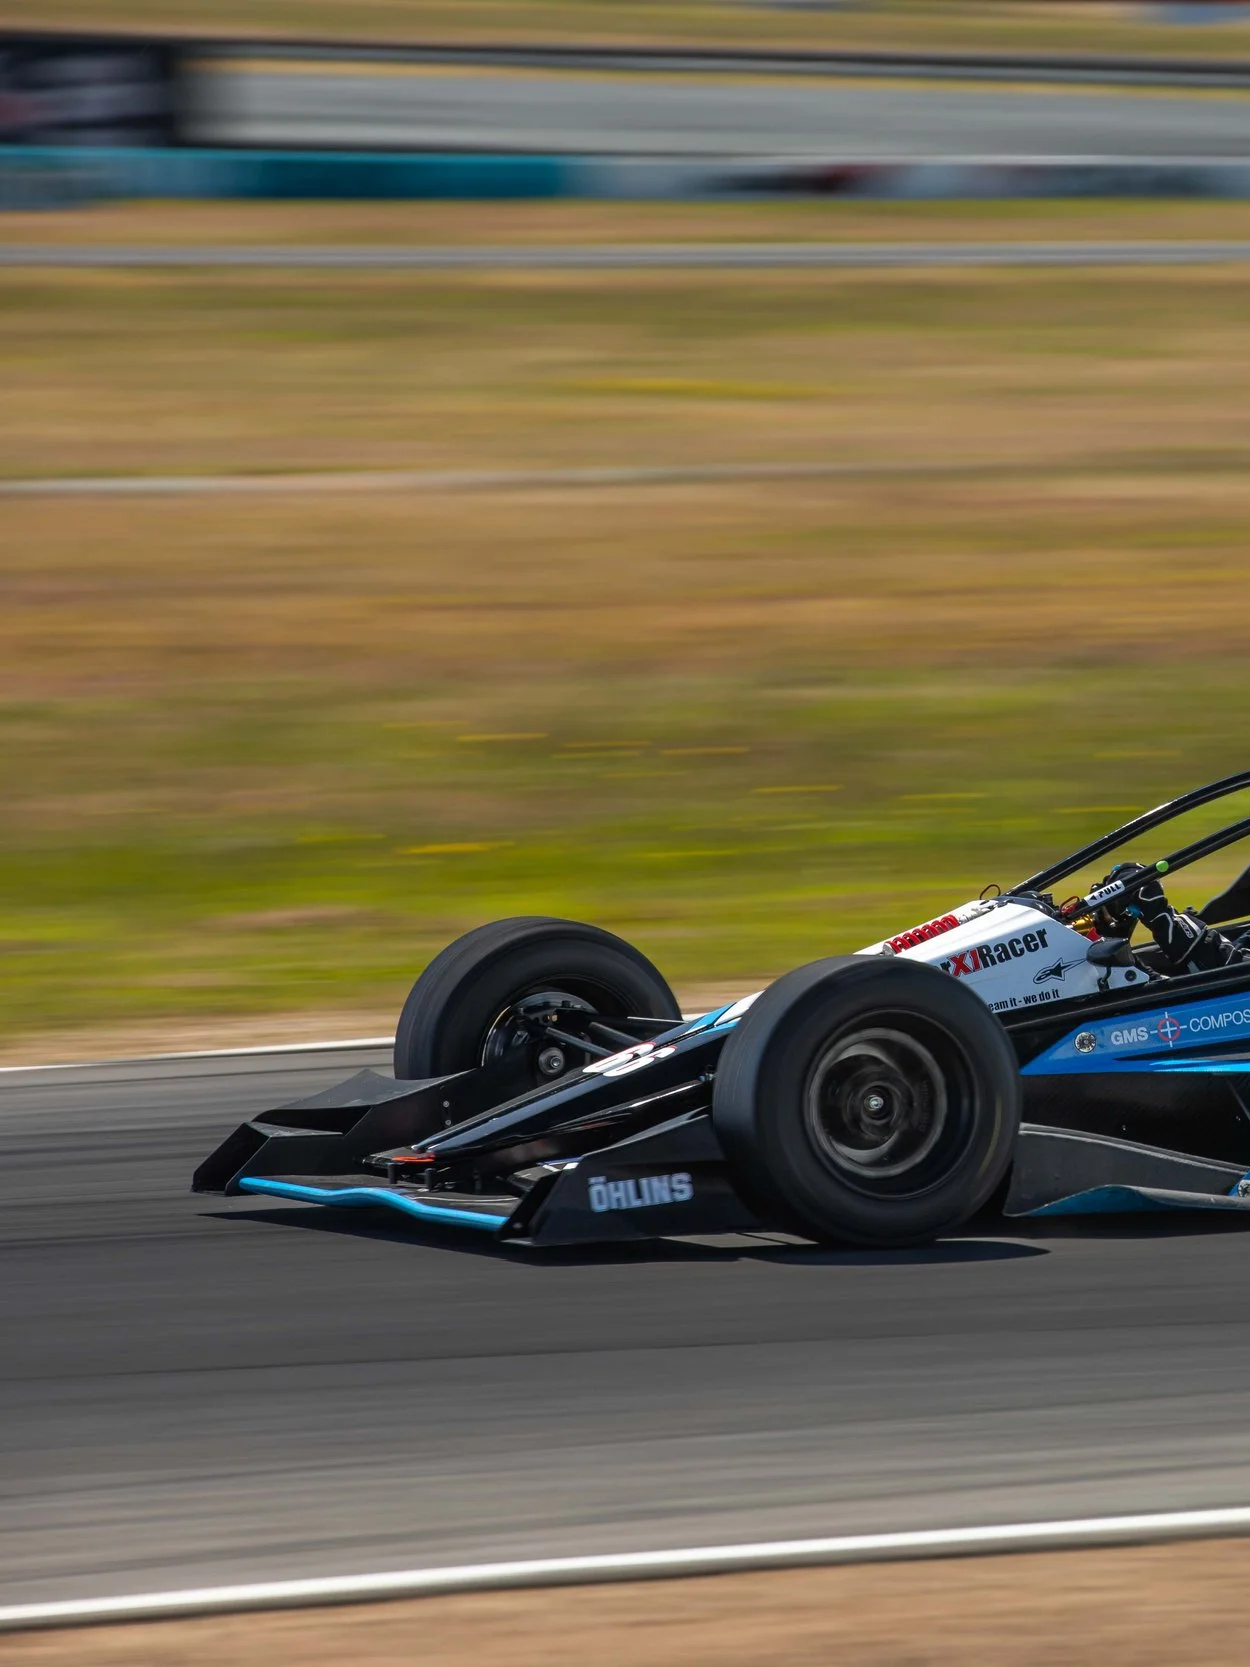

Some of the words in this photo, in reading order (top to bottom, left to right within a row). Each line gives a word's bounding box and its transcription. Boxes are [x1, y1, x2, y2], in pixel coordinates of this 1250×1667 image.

[1097, 883, 1122, 899] PULL
[936, 928, 1049, 977] rX1Racer
[988, 1000, 1009, 1012] eam
[1009, 998, 1018, 1008] it
[1023, 994, 1037, 1005] we
[1038, 991, 1051, 1002] do
[1051, 988, 1060, 999] it
[1110, 1027, 1149, 1046] GMS
[587, 1172, 693, 1213] ÖHLINS
